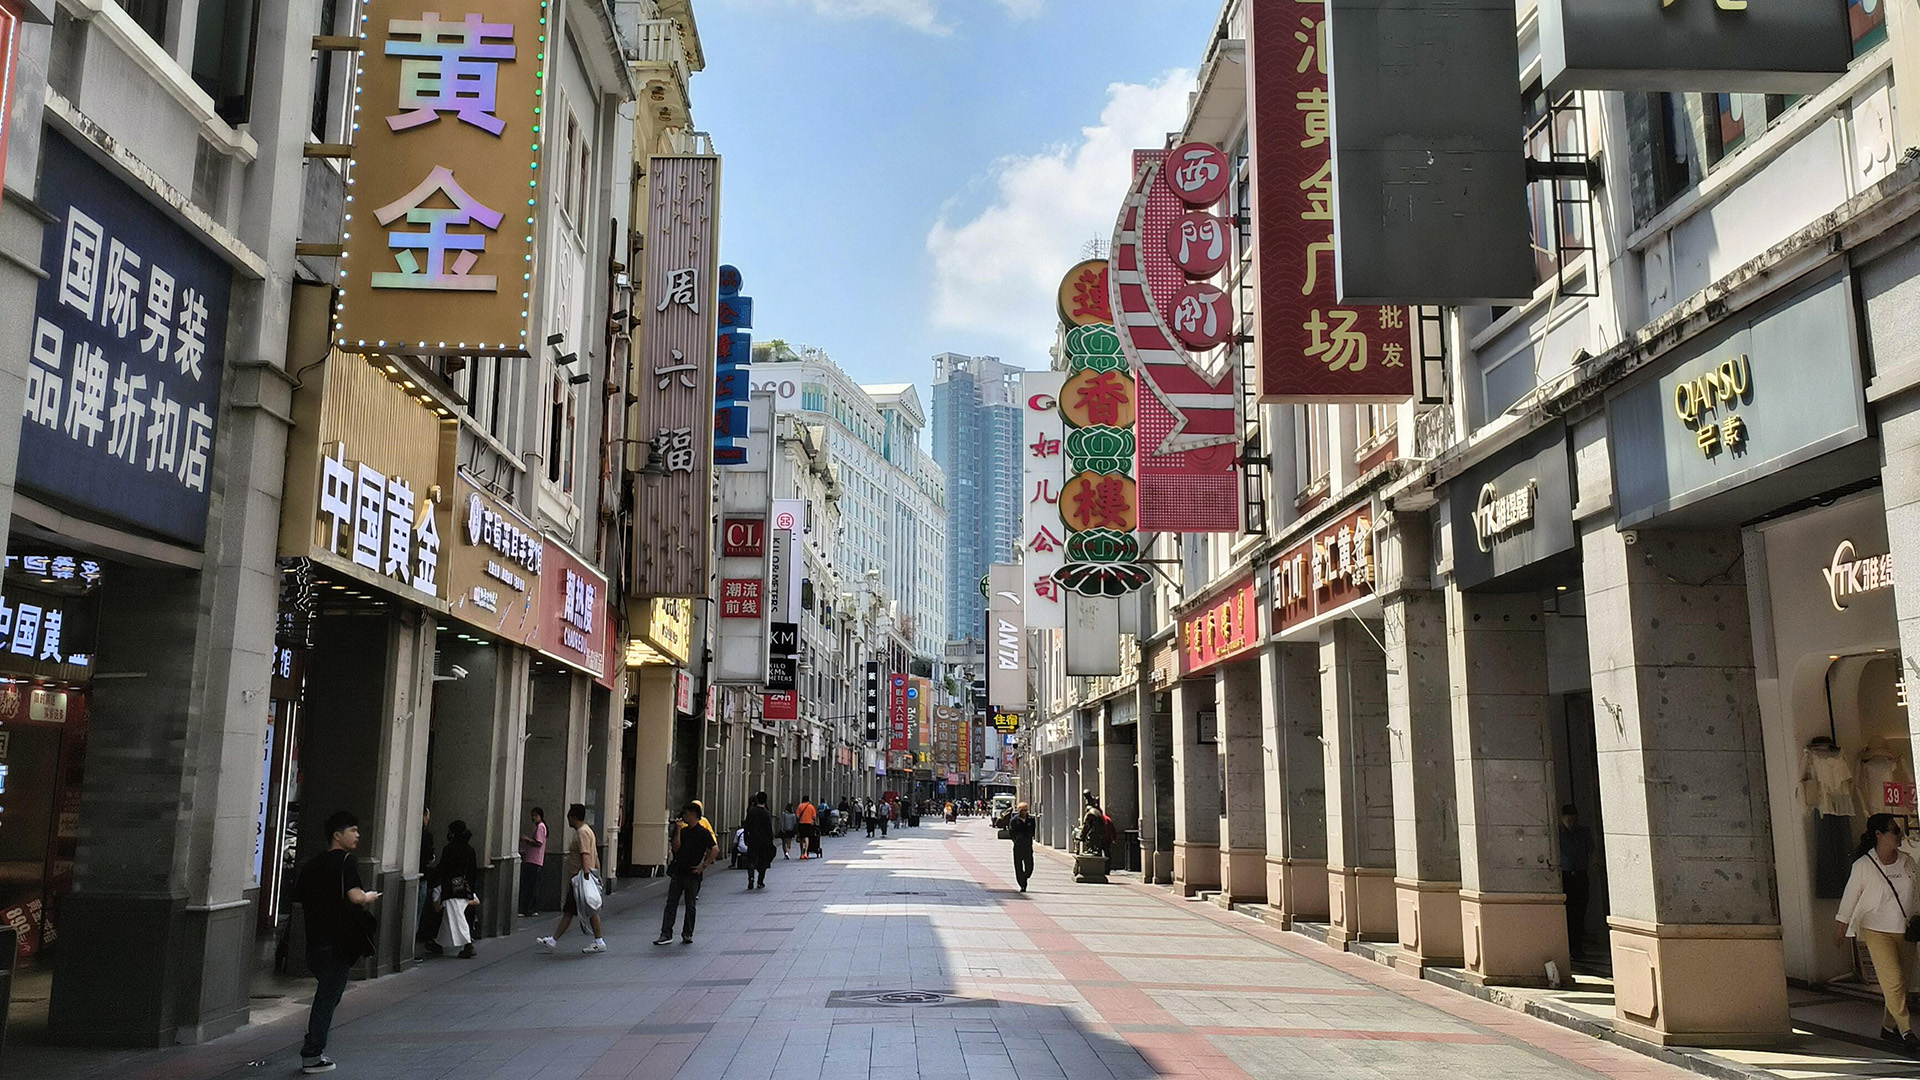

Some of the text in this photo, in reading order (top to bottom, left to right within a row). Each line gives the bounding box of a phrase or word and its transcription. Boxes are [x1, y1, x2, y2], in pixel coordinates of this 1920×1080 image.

[371, 13, 517, 292] 黄金
[1175, 150, 1223, 337] 西門町
[58, 205, 208, 382] 国际男装
[23, 317, 213, 492] 品牌折扣店
[655, 268, 699, 473] 周六福
[1675, 354, 1746, 421] QIANSU
[322, 441, 442, 597] 中国黄金
[727, 524, 760, 547] CL
[1029, 431, 1061, 603] 妇儿公司
[1312, 516, 1369, 591] 金汇黄金
[725, 600, 757, 614] 前线
[726, 583, 758, 597] 潮流
[770, 631, 794, 645] KM
[998, 618, 1019, 670] ANTA
[994, 714, 1018, 726] 住宿
[1887, 788, 1900, 804] 39
